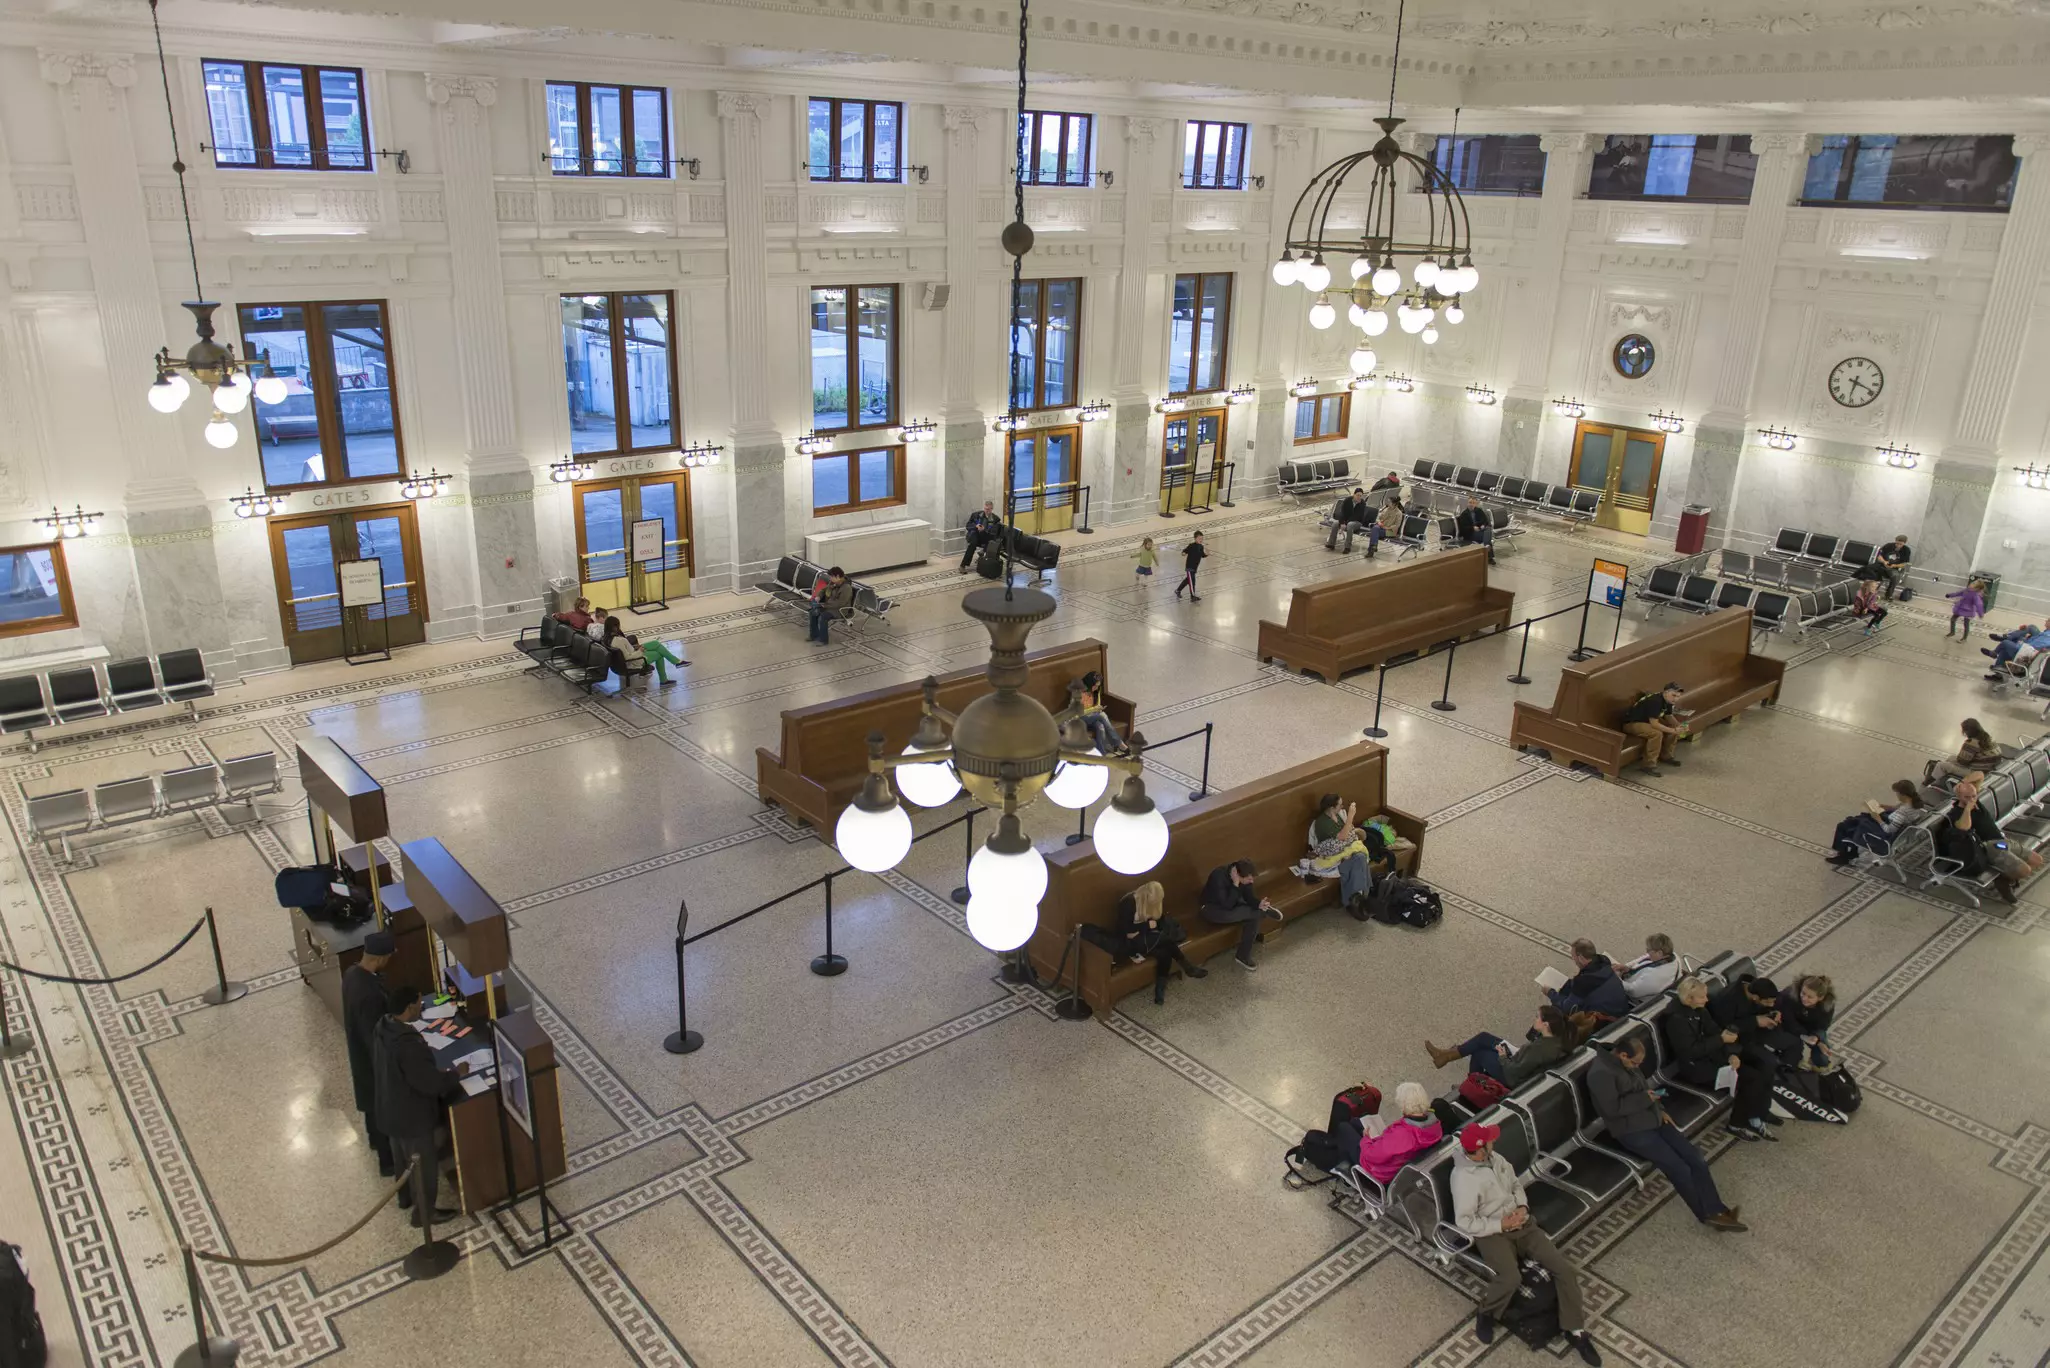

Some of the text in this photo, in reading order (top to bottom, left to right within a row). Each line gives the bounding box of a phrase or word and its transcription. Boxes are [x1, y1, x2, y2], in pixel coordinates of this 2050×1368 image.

[1187, 397, 1212, 408] GATE 8
[1031, 414, 1053, 425] GATE
[611, 459, 654, 473] GATE 6
[313, 489, 370, 507] GATE 5
[1772, 1085, 1841, 1122] DUNLOP
